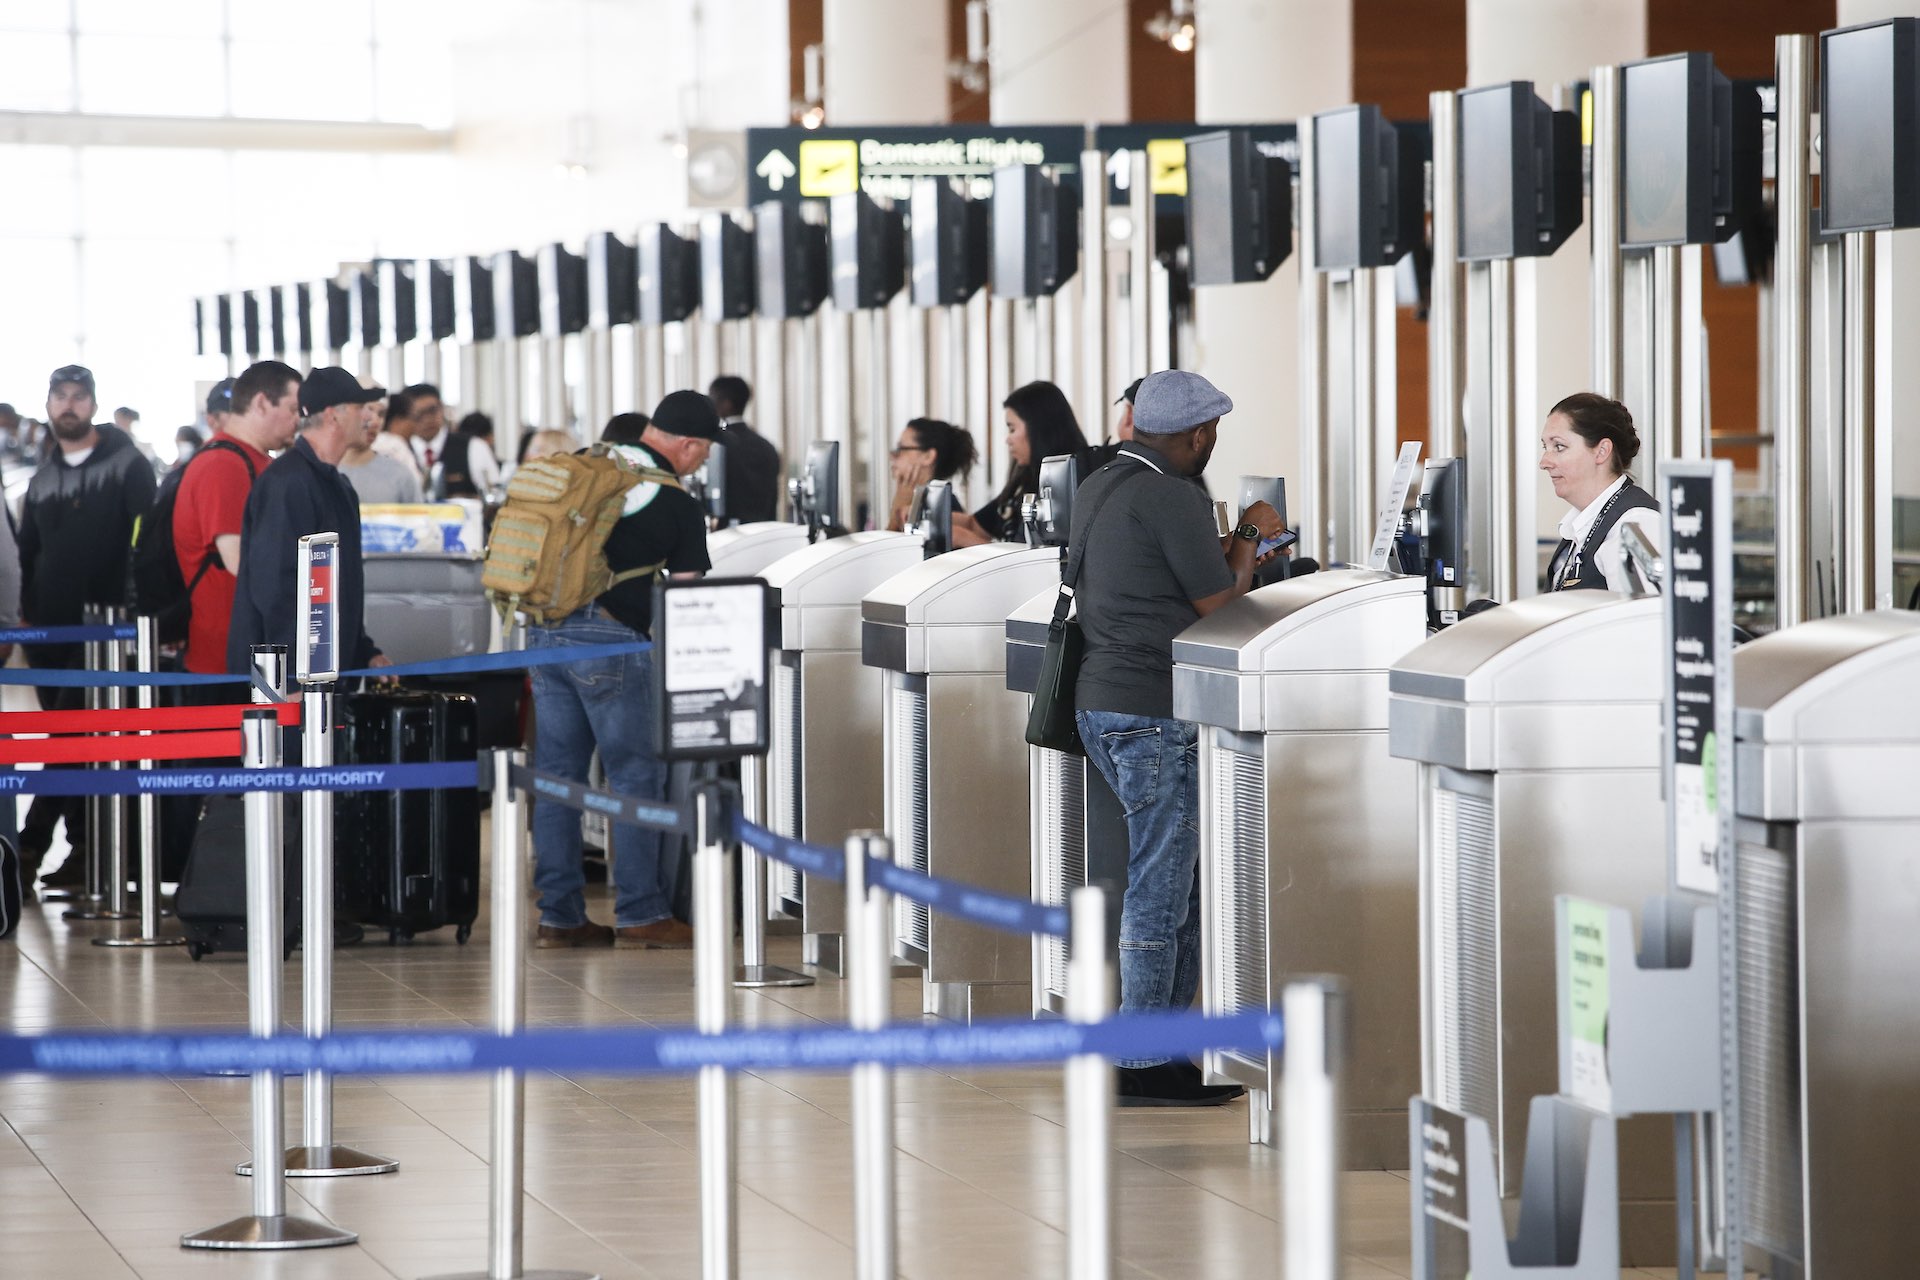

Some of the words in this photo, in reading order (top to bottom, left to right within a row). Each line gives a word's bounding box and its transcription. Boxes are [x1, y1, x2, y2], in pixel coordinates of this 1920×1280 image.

[313, 551, 326, 560] DELTA
[137, 775, 215, 788] WINNIPEG
[218, 773, 295, 787] AIRPORTS
[299, 771, 386, 786] AUTHORITY
